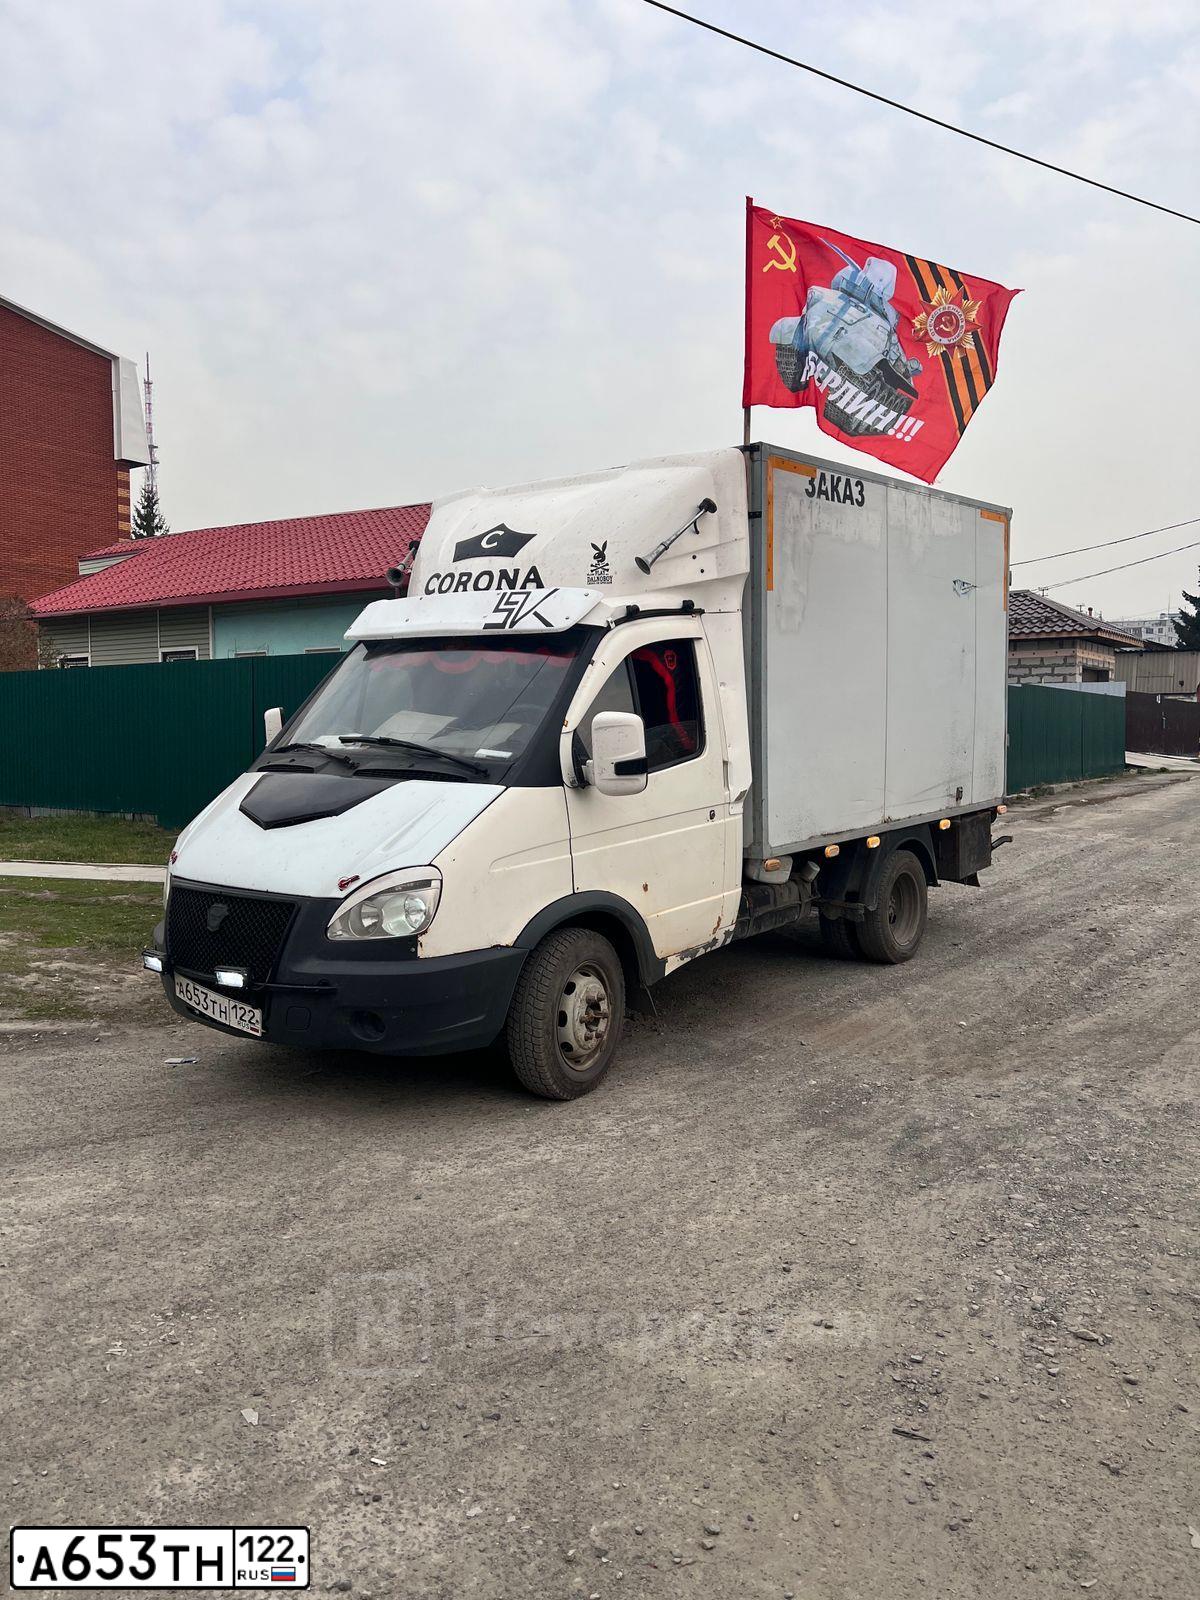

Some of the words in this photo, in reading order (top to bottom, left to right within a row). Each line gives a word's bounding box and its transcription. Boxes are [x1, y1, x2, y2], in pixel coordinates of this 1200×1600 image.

[804, 472, 865, 507] ЗАКАЗ
[424, 565, 545, 596] CORONA
[179, 982, 228, 1021] А653ТН
[231, 1004, 256, 1025] 122
[237, 1021, 250, 1030] RUS
